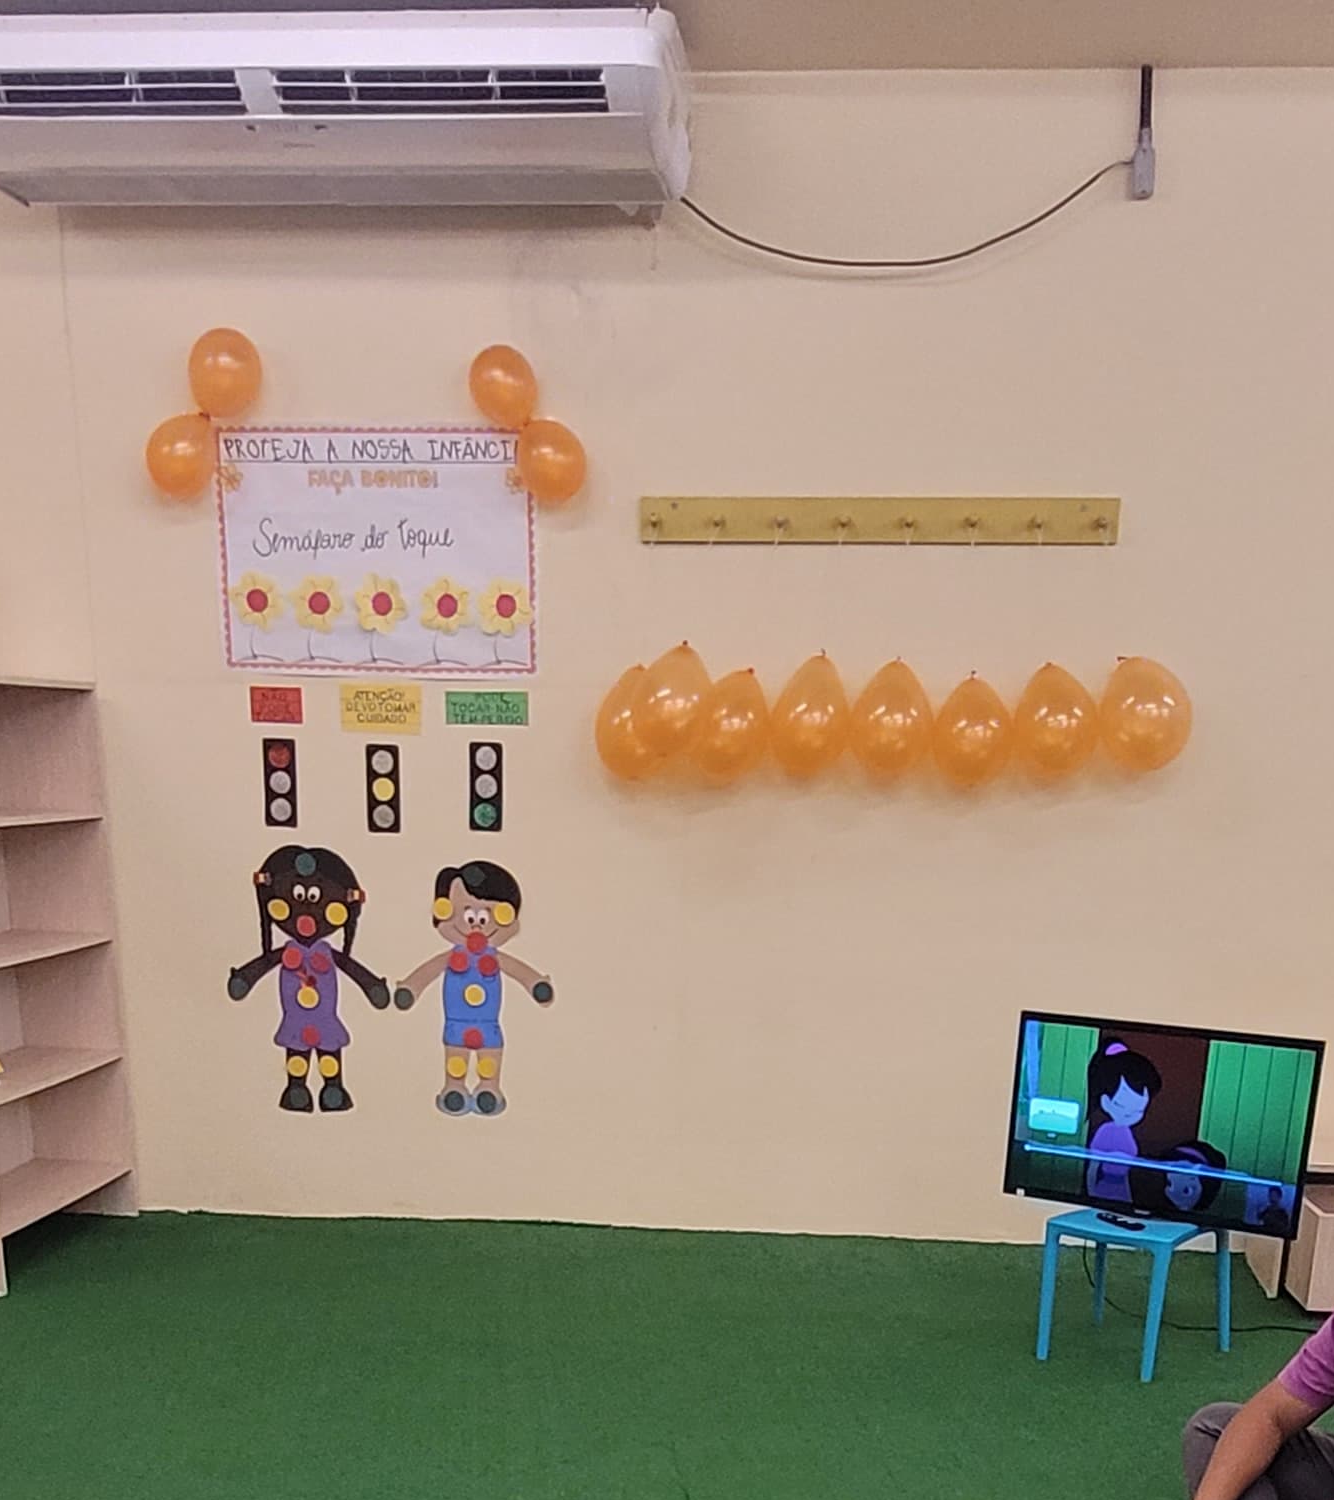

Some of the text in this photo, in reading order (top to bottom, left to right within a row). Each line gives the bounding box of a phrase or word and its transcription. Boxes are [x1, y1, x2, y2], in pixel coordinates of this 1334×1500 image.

[327, 440, 339, 463] A
[351, 440, 414, 463] NOSSA
[308, 470, 439, 494] FAÇA BONITO!
[361, 525, 389, 552] do
